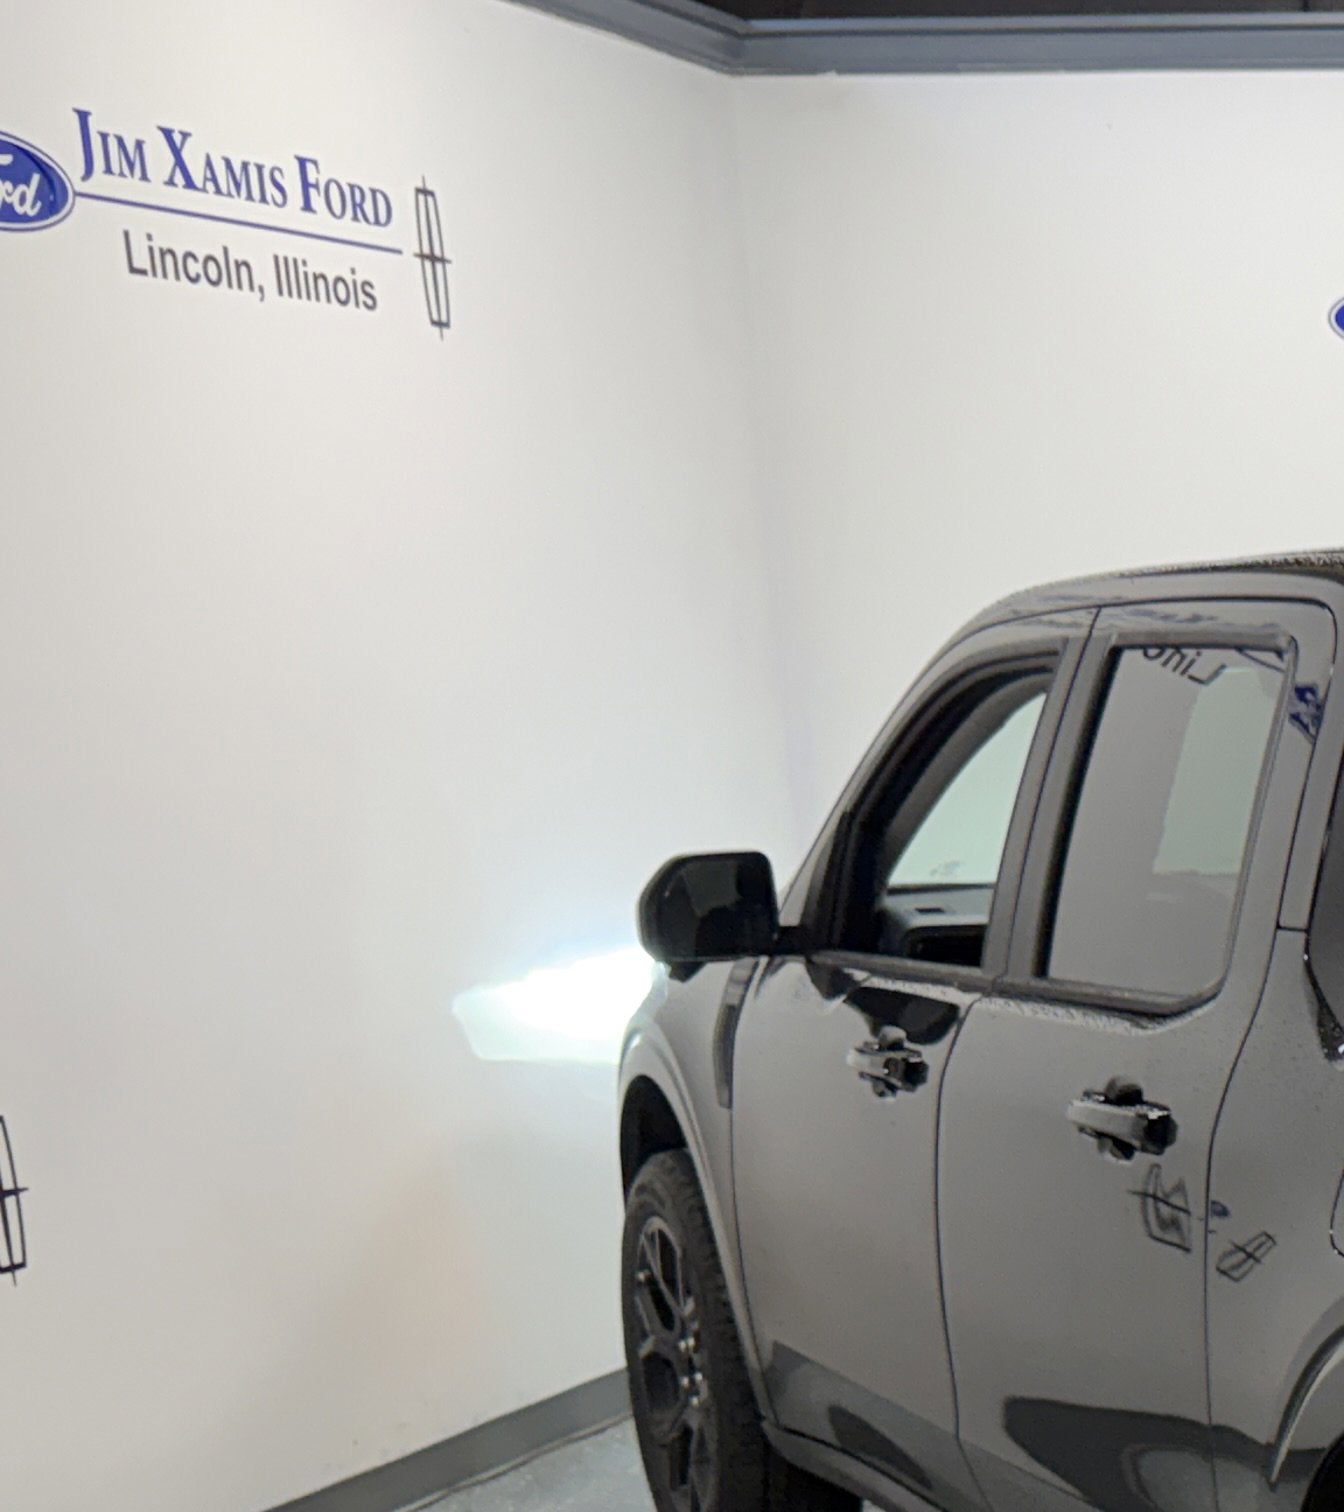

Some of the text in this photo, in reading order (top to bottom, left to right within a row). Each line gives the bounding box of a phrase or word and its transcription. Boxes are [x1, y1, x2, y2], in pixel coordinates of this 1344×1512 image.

[72, 107, 392, 228] JIM XAMIS FORD
[123, 229, 378, 311] Lincoln, Illinois
